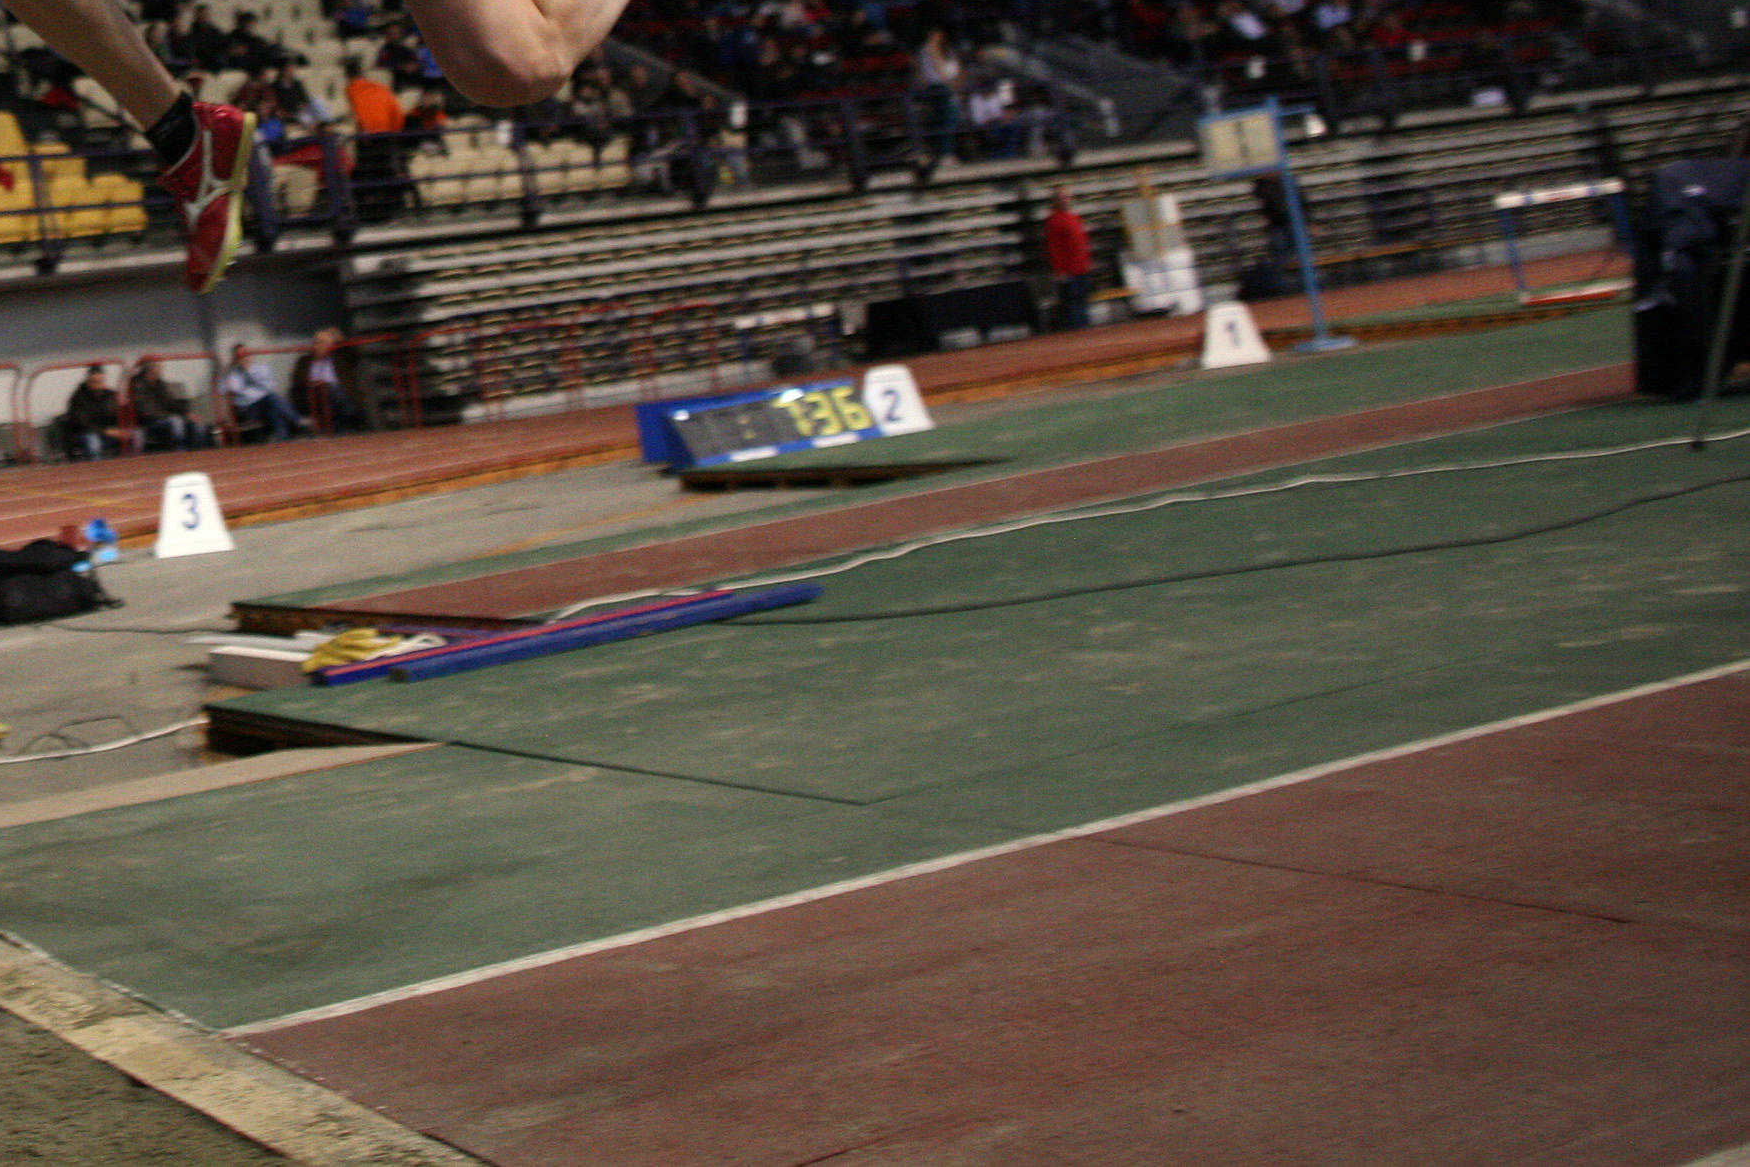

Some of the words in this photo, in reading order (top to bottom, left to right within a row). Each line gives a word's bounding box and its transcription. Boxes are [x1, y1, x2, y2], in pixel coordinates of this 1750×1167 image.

[1224, 320, 1241, 347] 1
[882, 388, 902, 423] 2
[182, 493, 201, 530] 3
